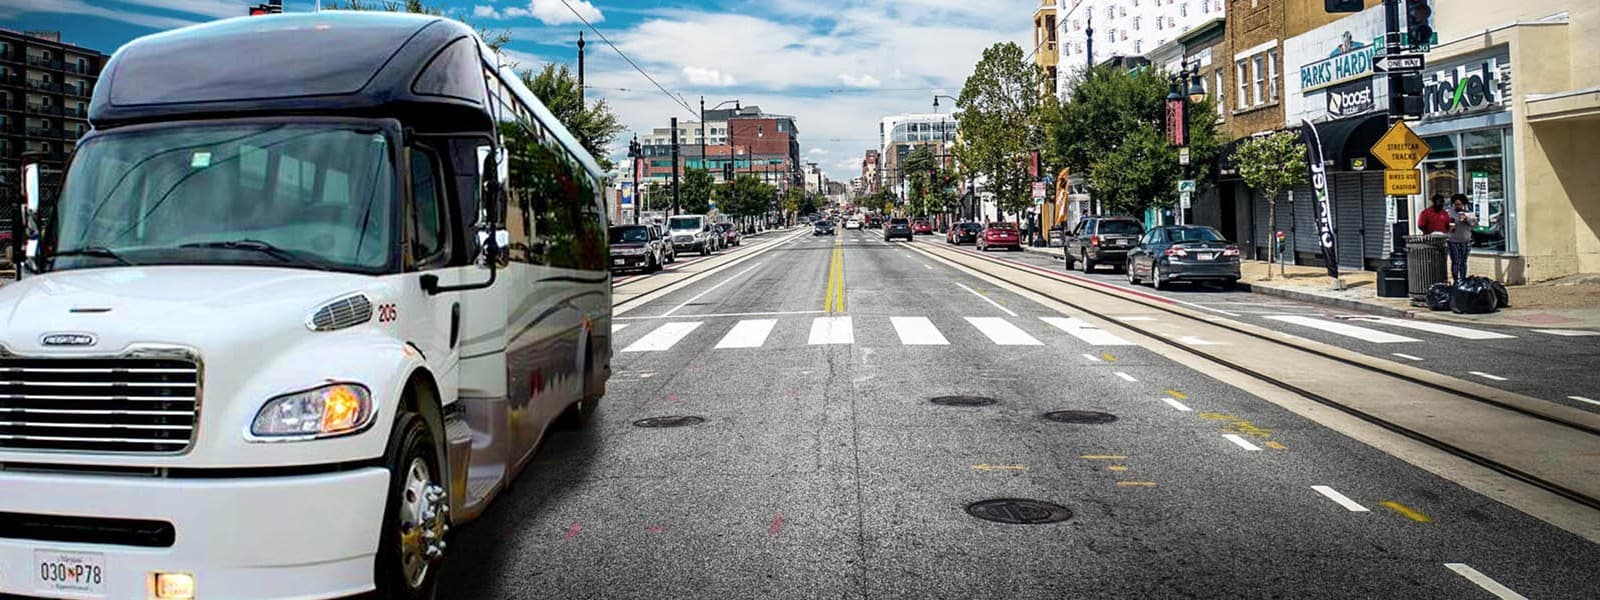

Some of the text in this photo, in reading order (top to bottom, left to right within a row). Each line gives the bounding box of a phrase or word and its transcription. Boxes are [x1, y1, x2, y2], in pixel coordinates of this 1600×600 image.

[1300, 49, 1373, 88] PARKS HARDW
[1388, 58, 1419, 67] ONE WAY
[1341, 86, 1371, 107] boost
[1423, 62, 1494, 112] ricket
[1387, 143, 1419, 151] STREETCAR
[378, 304, 397, 322] 205
